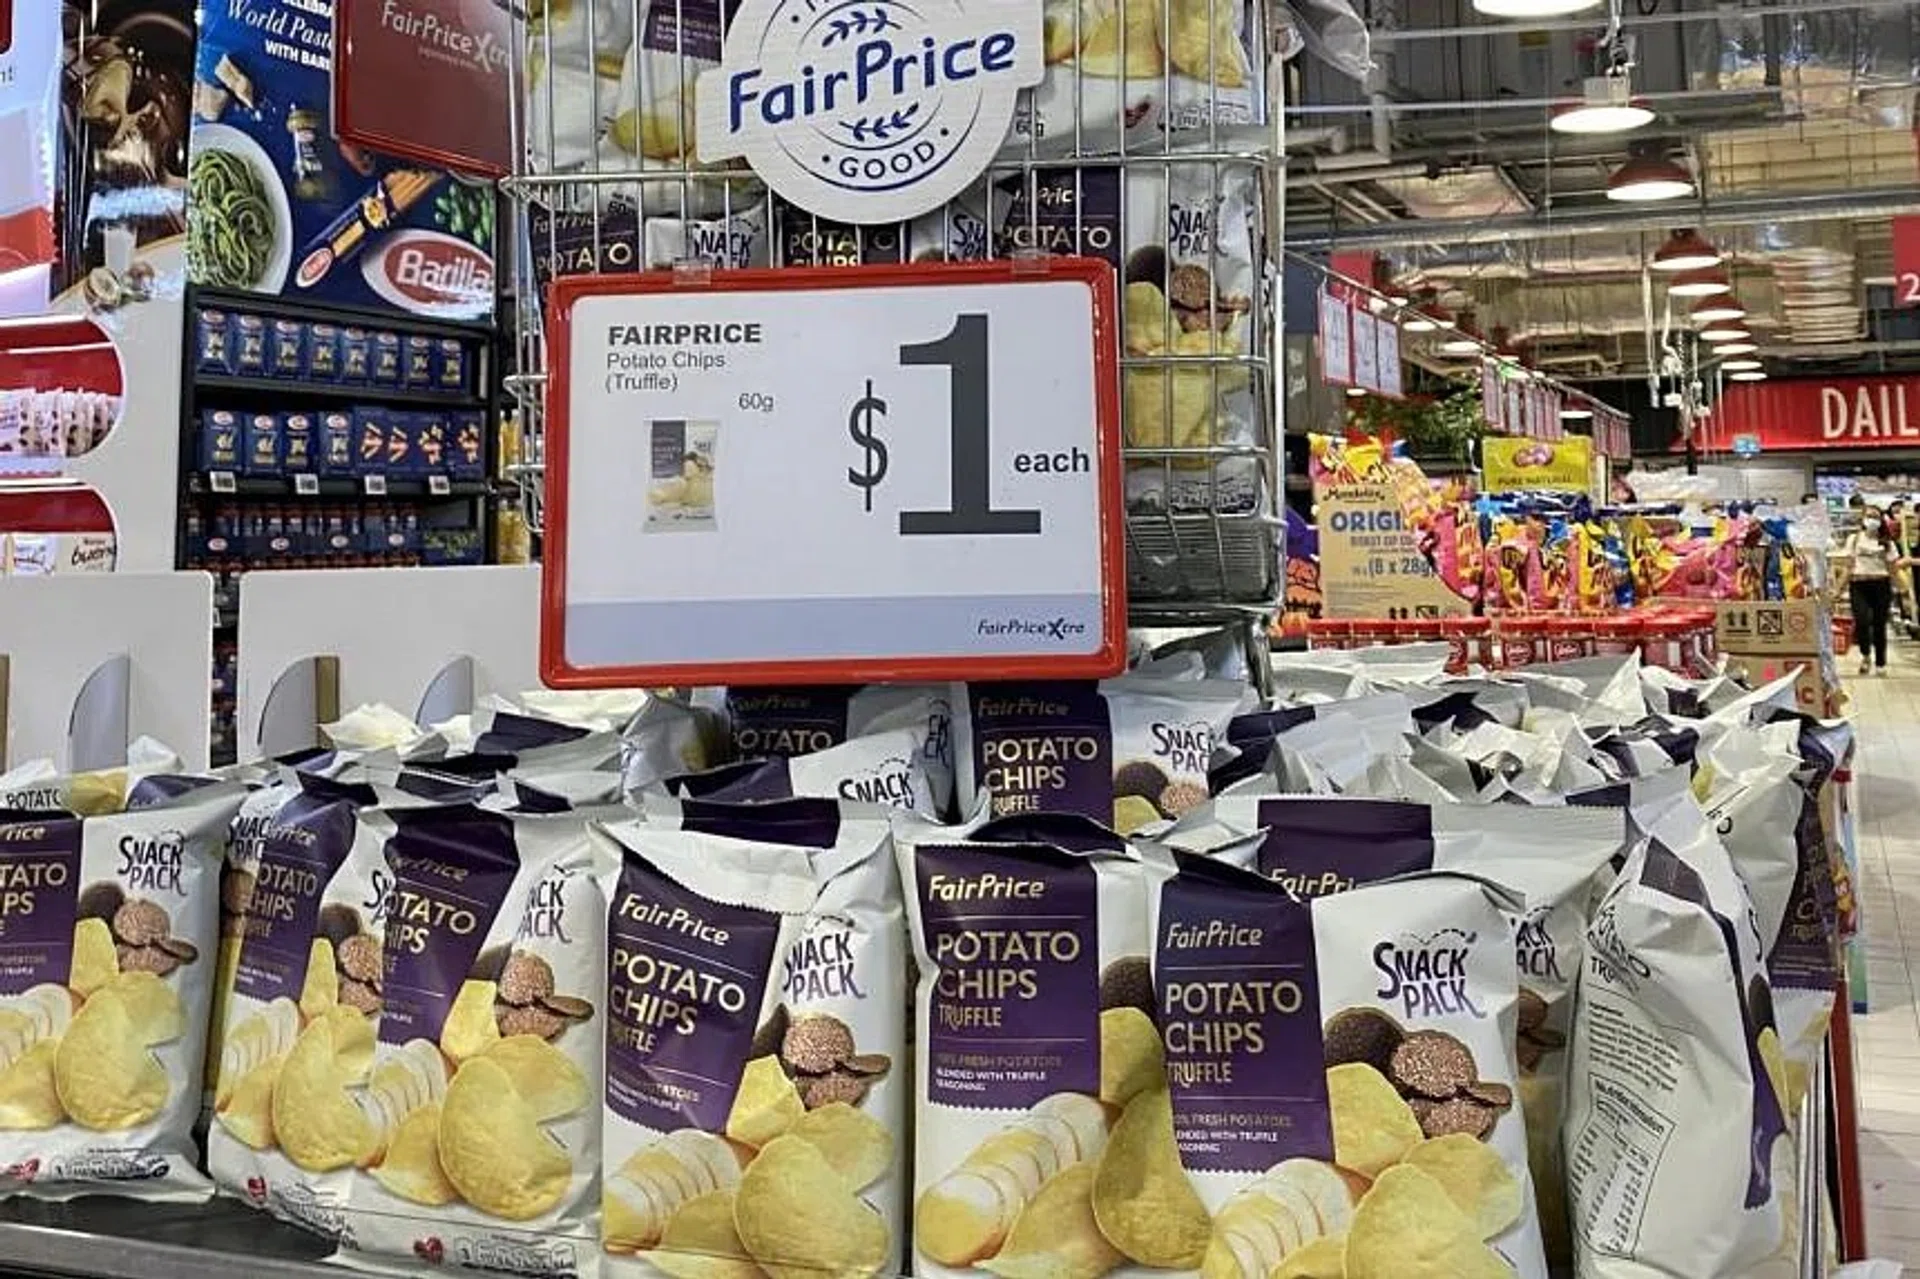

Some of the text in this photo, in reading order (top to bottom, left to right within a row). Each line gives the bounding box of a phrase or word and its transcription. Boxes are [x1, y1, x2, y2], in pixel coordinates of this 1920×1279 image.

[228, 0, 286, 36] World
[265, 39, 299, 63] WITH
[728, 32, 1017, 134] FairPrice
[839, 140, 936, 180] GOOD
[395, 248, 495, 294] Barilla
[608, 323, 763, 346] FAIRPRICE
[607, 351, 726, 371] Potato Chips
[605, 373, 678, 394] (Truffle)
[738, 393, 774, 412] 60g
[1821, 385, 1919, 439] DAIL
[1013, 447, 1090, 473] each
[983, 736, 1098, 764] POTATO
[984, 765, 1067, 792] CHIPS
[117, 835, 185, 875] SNACK
[129, 866, 188, 897] PACK
[928, 873, 1046, 902] FairPrice
[618, 892, 731, 947] FairPrice
[1166, 920, 1263, 949] FairPrice
[937, 930, 1081, 962] POTATO
[611, 948, 746, 1013] POTATO
[791, 962, 867, 1004] PACK
[937, 967, 1038, 1001] CHIPS
[1373, 941, 1469, 999] SNACK
[610, 985, 699, 1035] CHIPS
[1164, 980, 1303, 1015] POTATO
[1402, 978, 1487, 1020] PACK
[937, 1003, 1002, 1031] TRUFFLE
[1164, 1021, 1265, 1054] CHIPS
[1167, 1061, 1233, 1088] TRUFFLE
